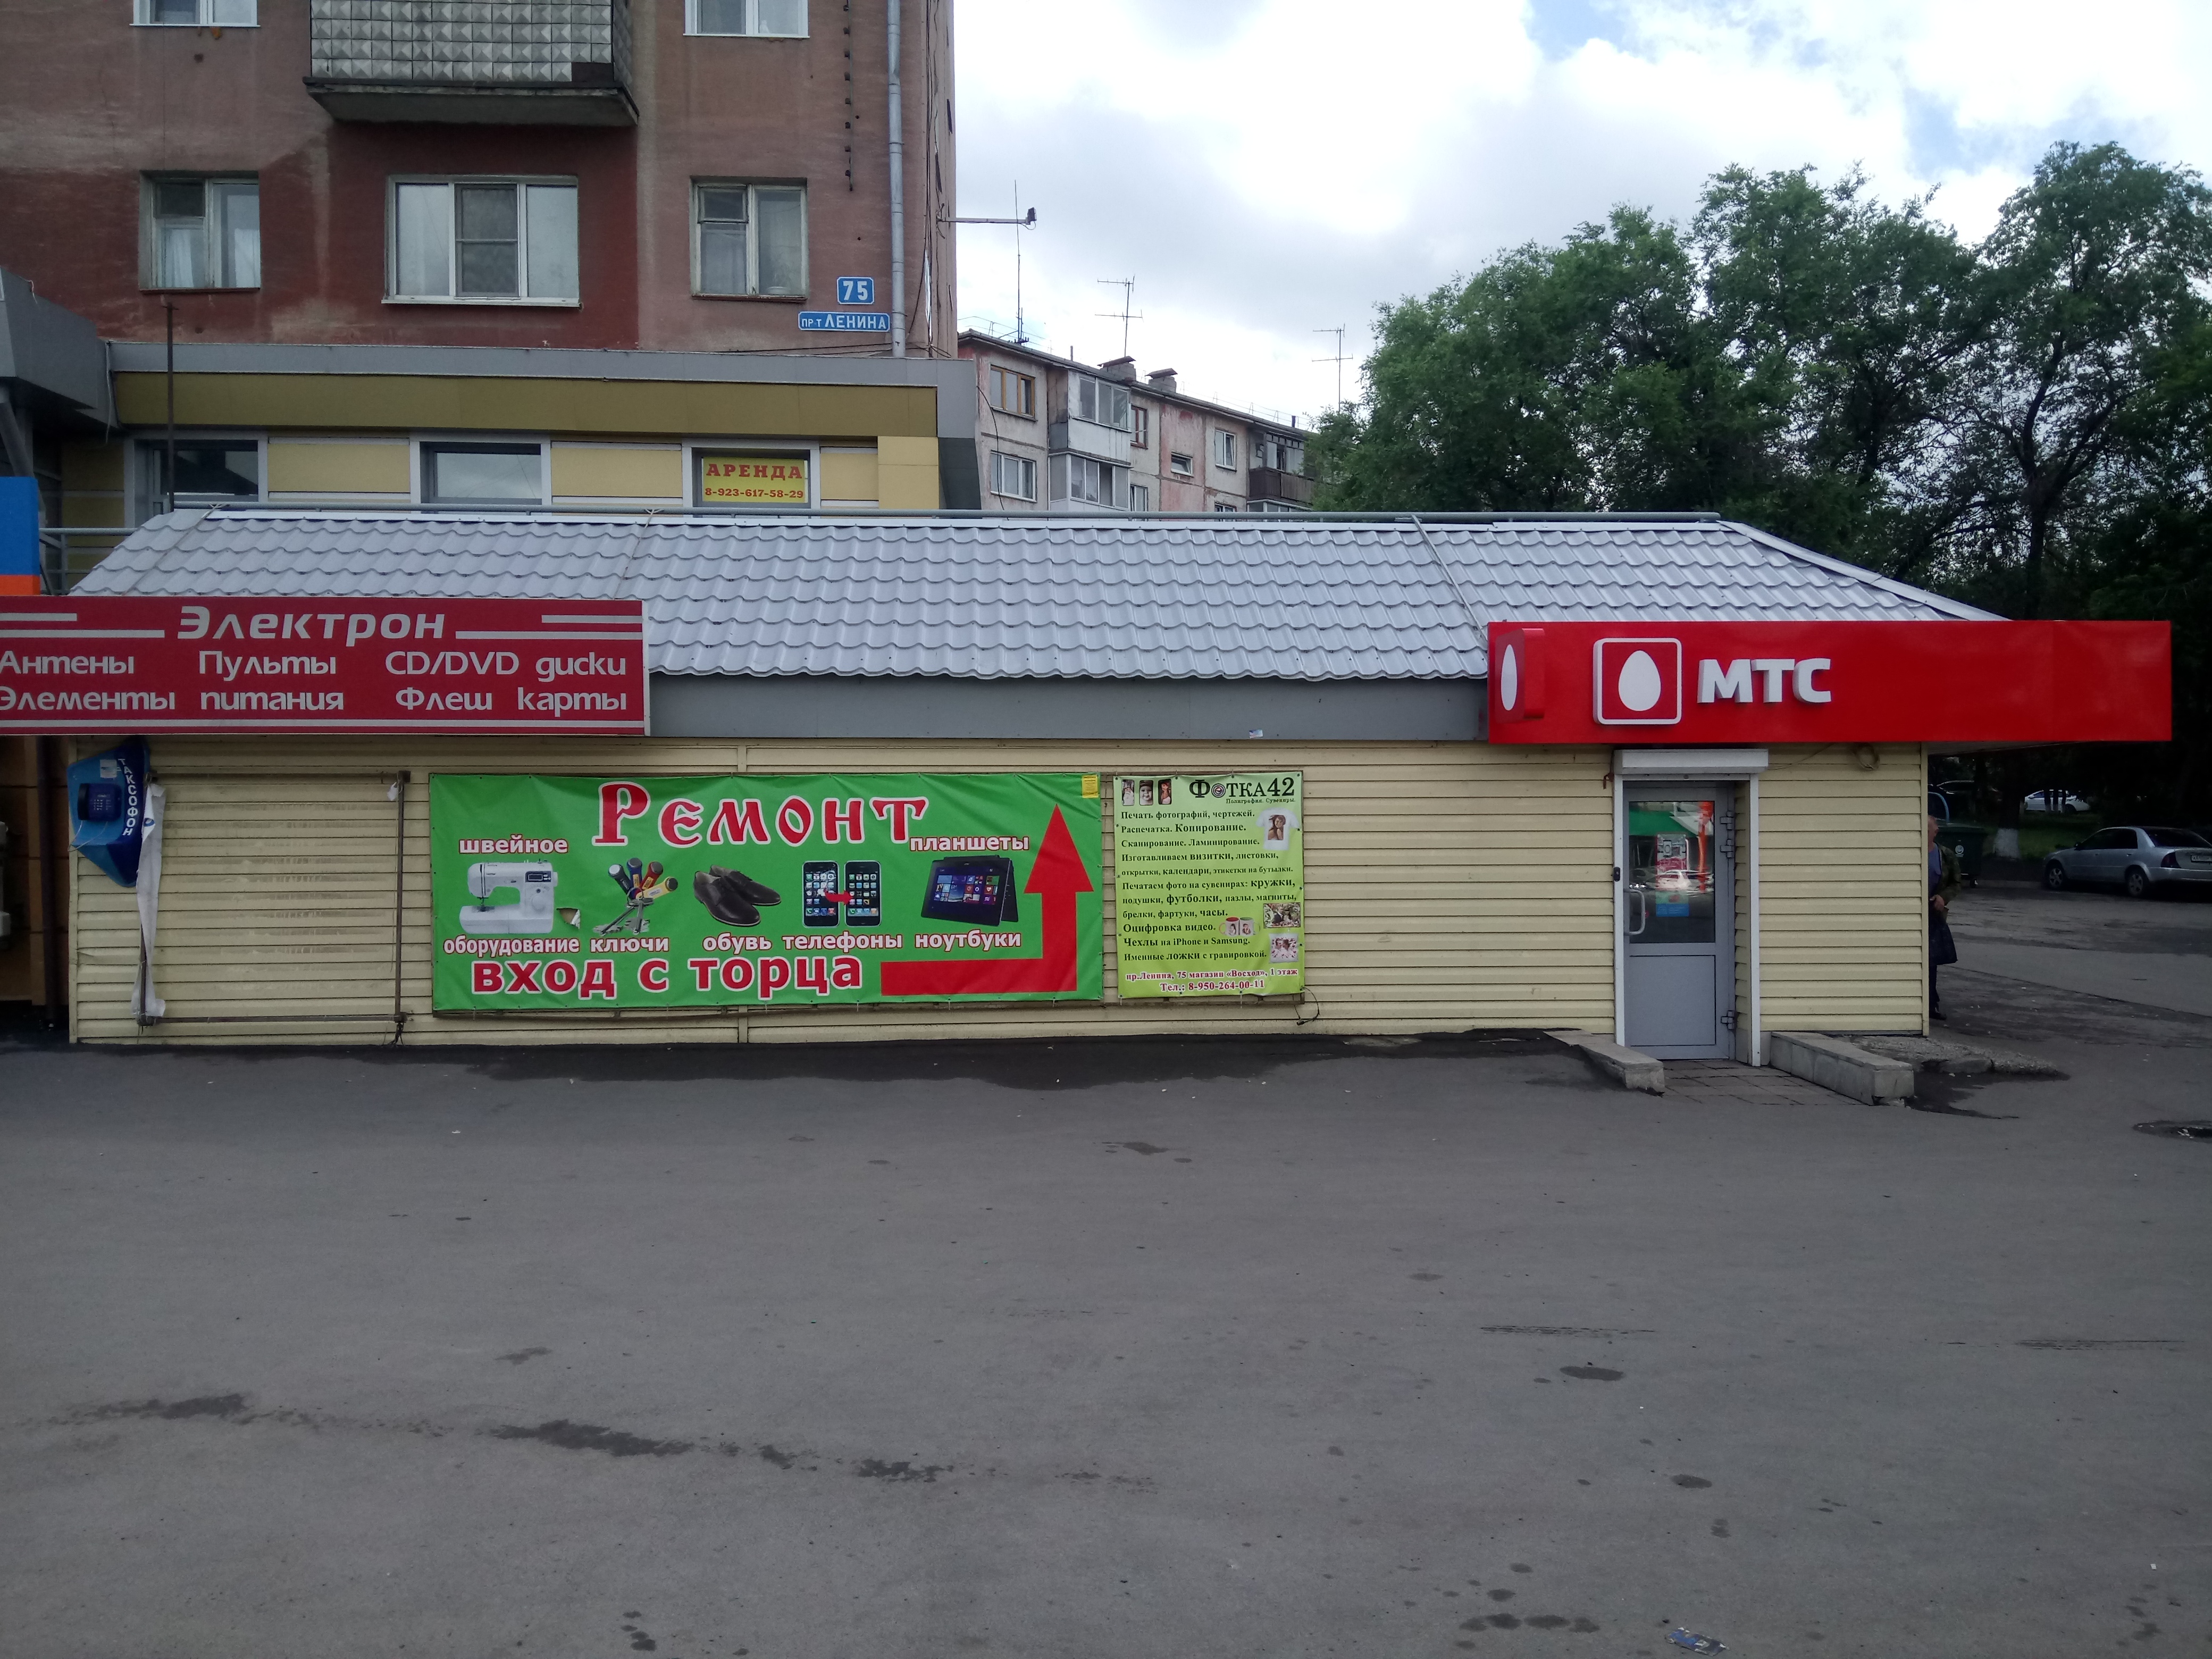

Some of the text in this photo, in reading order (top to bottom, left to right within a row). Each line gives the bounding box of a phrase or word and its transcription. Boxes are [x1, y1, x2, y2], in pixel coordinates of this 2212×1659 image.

[843, 280, 868, 300] 75
[825, 314, 886, 329] ЛЕНИНА
[706, 464, 802, 481] АРЕНДА
[705, 488, 803, 498] 8-923-617-58-29
[177, 605, 445, 647] Электрон
[0, 650, 625, 682] Антены Пульты CD/DVD диски
[1697, 658, 1831, 703] МТС
[0, 686, 626, 717] Элементы питания Флеш карты
[118, 758, 139, 836] ТАКСОФОН
[1156, 811, 1210, 820] фотографий,
[1213, 810, 1255, 819] чертежей.
[1175, 824, 1246, 834] Копирование.
[459, 834, 568, 854] швейное
[909, 835, 1029, 851] планшеты
[1121, 839, 1260, 849] Сканирование. Ламинирование.
[1166, 882, 1187, 891] фото
[1251, 879, 1295, 889] кружки,
[1167, 894, 1222, 905] футболки,
[1123, 911, 1155, 919] брелки,
[1158, 910, 1197, 919] фартуки,
[1123, 924, 1182, 934] Оцифровка
[443, 935, 580, 957] оборудование
[590, 936, 669, 953] ключи
[702, 932, 772, 956] обувь
[782, 931, 902, 953] телефоны
[915, 929, 1021, 952] ноутбуки
[1124, 938, 1158, 946] Чехлы
[1210, 951, 1267, 960] гравировкой.
[1126, 972, 1175, 982] пр.Ленина,
[1160, 979, 1265, 992] Тел.: 8-950-264-00-11
